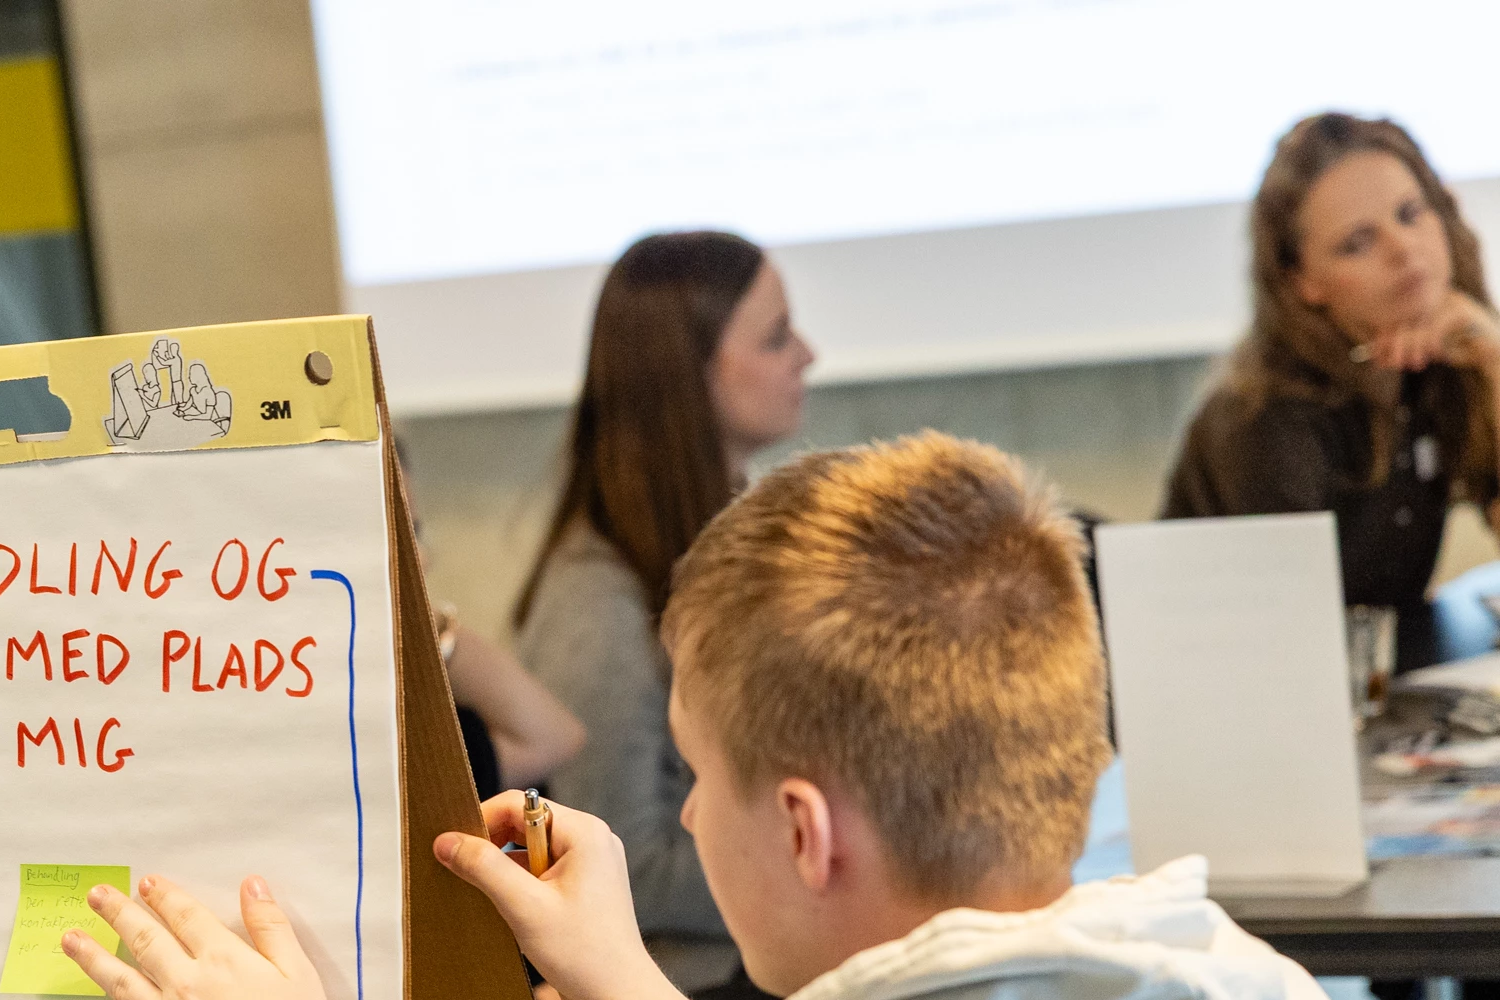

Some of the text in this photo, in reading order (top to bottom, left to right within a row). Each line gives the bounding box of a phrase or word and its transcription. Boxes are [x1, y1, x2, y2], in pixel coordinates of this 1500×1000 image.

[260, 400, 292, 420] 3M
[211, 537, 297, 602] OG
[5, 628, 131, 686] MED
[161, 629, 318, 698] PLADS
[16, 716, 135, 773] MIG
